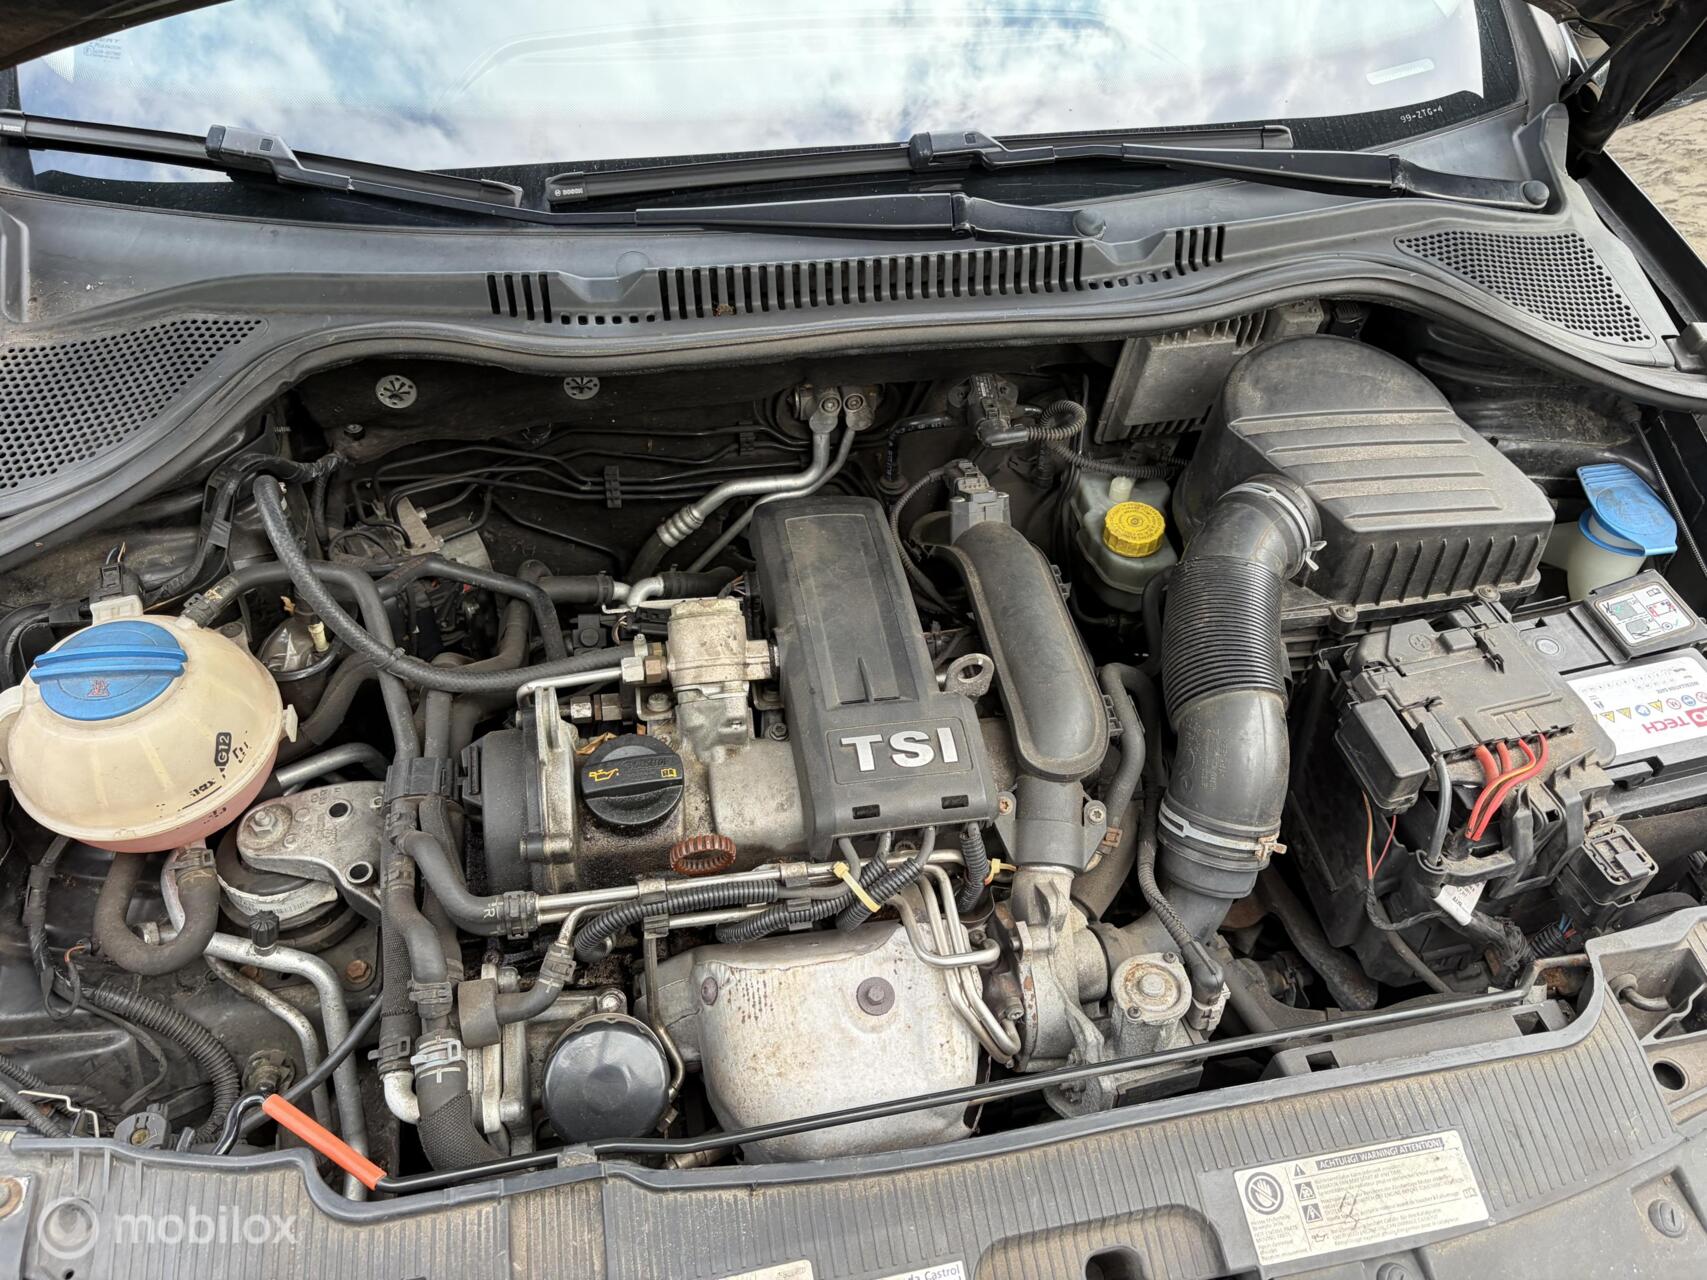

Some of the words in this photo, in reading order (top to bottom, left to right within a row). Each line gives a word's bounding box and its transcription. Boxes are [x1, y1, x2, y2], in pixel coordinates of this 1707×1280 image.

[1400, 105, 1443, 124] 99-ZTG-4
[217, 734, 230, 763] G12
[840, 726, 958, 772] TSI
[1319, 1153, 1358, 1169] ACHTUNG!
[1359, 1146, 1398, 1161] WARNING!
[1399, 1138, 1443, 1154] ATTENTION!
[925, 1264, 960, 1280] Castrol
